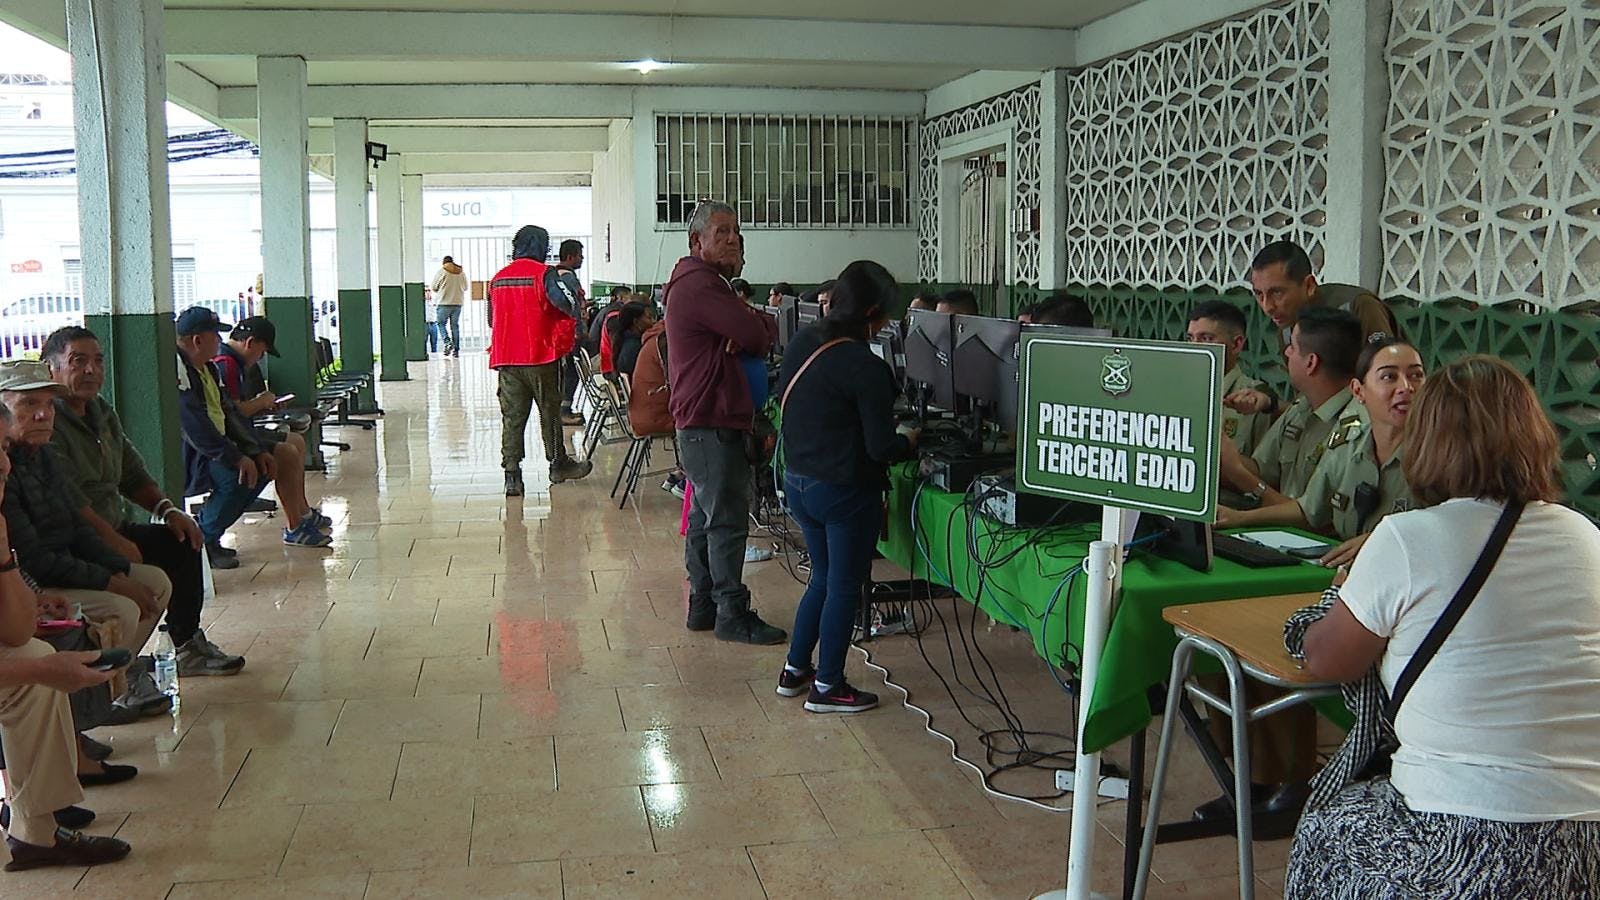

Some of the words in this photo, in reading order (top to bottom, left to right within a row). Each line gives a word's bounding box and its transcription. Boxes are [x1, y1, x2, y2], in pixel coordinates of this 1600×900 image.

[441, 201, 481, 216] sura
[1038, 402, 1195, 454] PREFERENCIAL
[1036, 439, 1128, 484] TERCERA
[1135, 452, 1196, 493] EDAD
